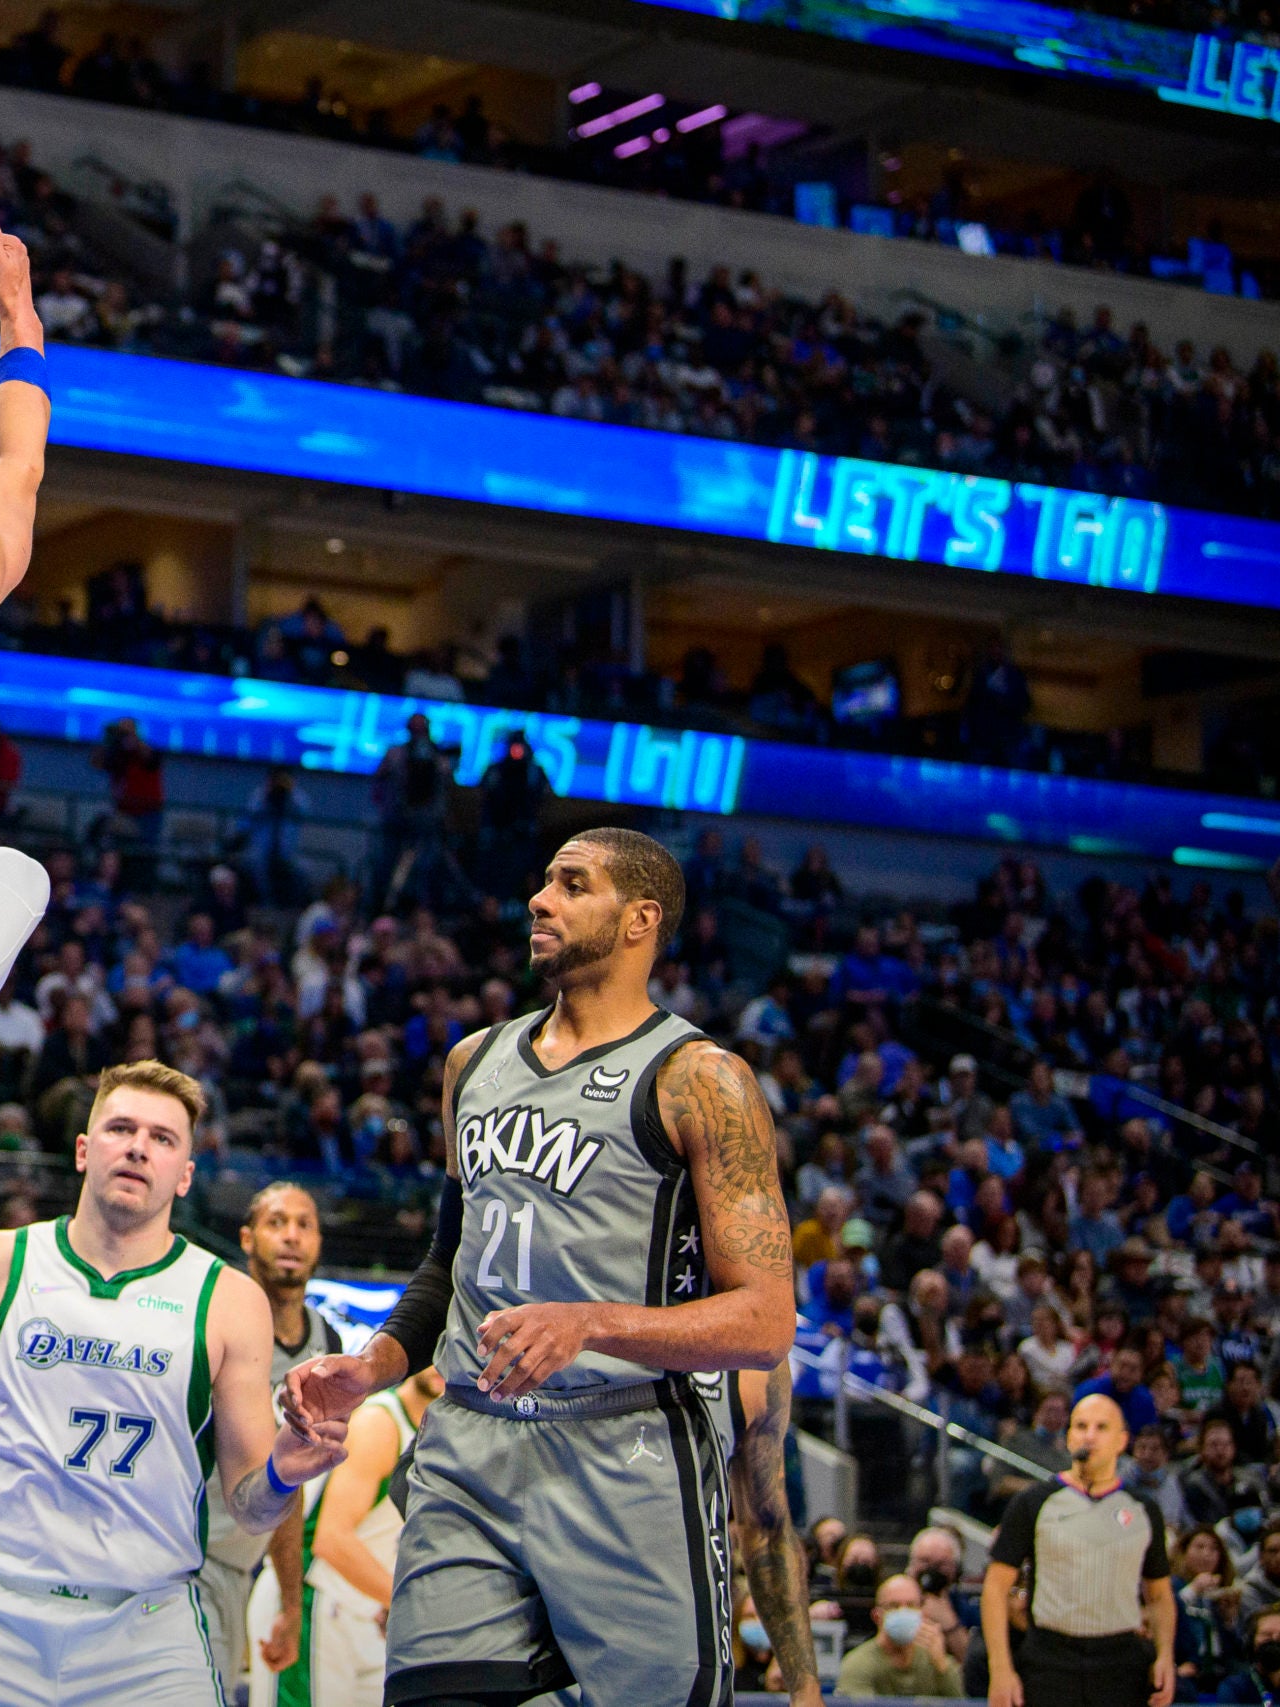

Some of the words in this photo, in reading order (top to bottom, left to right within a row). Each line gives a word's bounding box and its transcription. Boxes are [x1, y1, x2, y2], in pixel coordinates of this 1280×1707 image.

[1185, 32, 1280, 123] LE
[766, 447, 1011, 572] LET'S
[584, 1087, 617, 1099] Webull
[460, 1105, 605, 1197] BKLYN
[477, 1199, 535, 1292] 21
[137, 1295, 184, 1314] chime
[20, 1326, 172, 1377] DALLAS
[64, 1407, 156, 1478] 77
